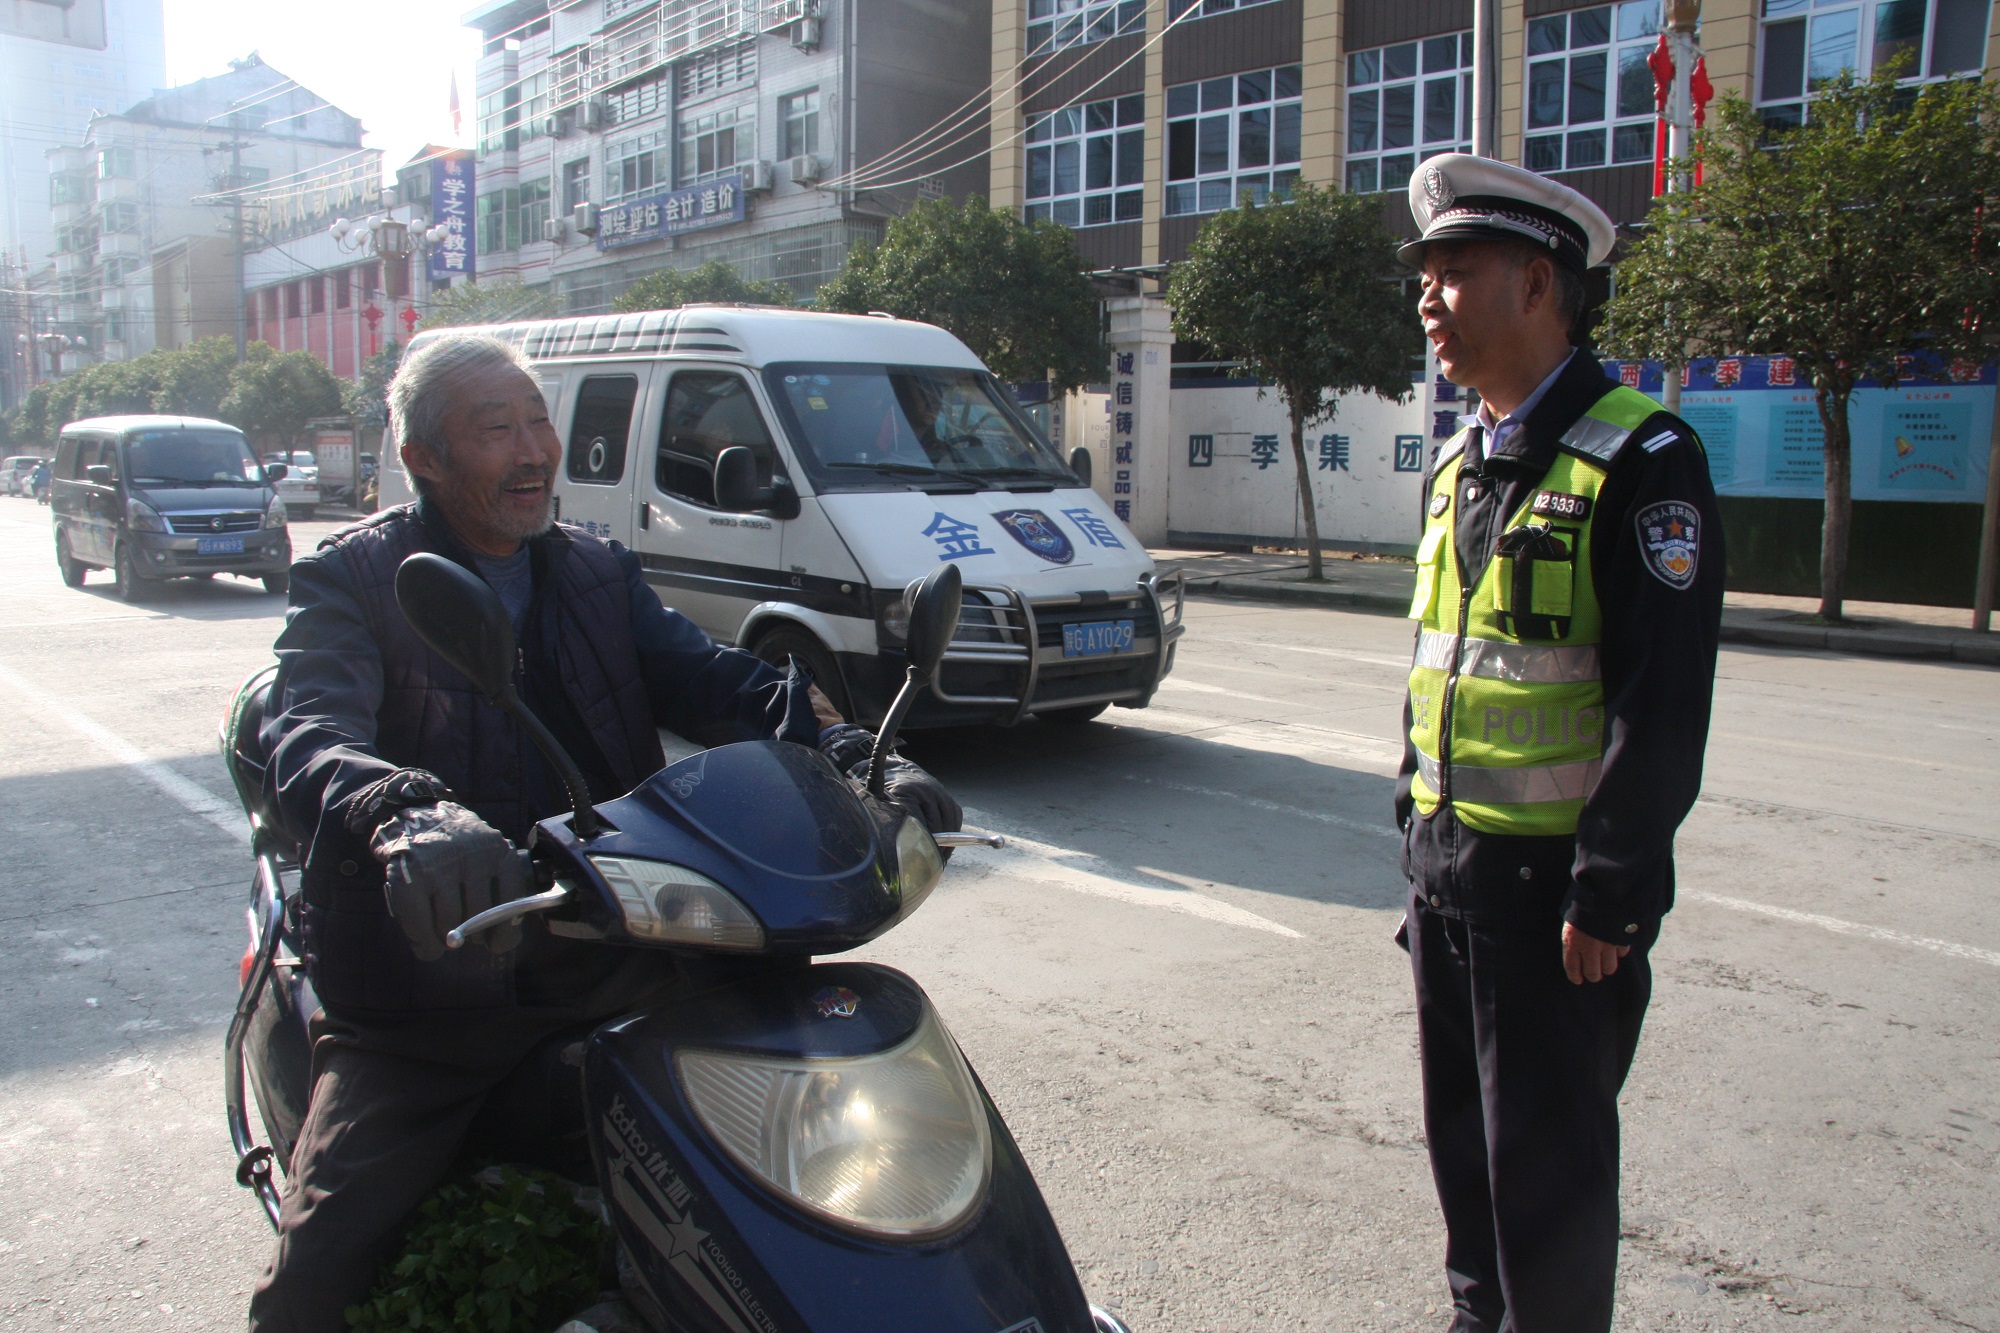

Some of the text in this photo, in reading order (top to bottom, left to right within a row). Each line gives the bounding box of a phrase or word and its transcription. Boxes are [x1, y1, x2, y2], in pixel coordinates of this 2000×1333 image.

[442, 178, 467, 269] 学之舟教育
[600, 209, 626, 237] 测绘
[630, 203, 659, 231] 评估
[665, 193, 695, 221] 会计
[701, 183, 734, 215] 造价
[1115, 352, 1134, 523] 诚信铸就品质
[1189, 434, 1424, 472] 四季集团
[921, 507, 1127, 561] 金 盾
[706, 1239, 742, 1288] YOOHOO
